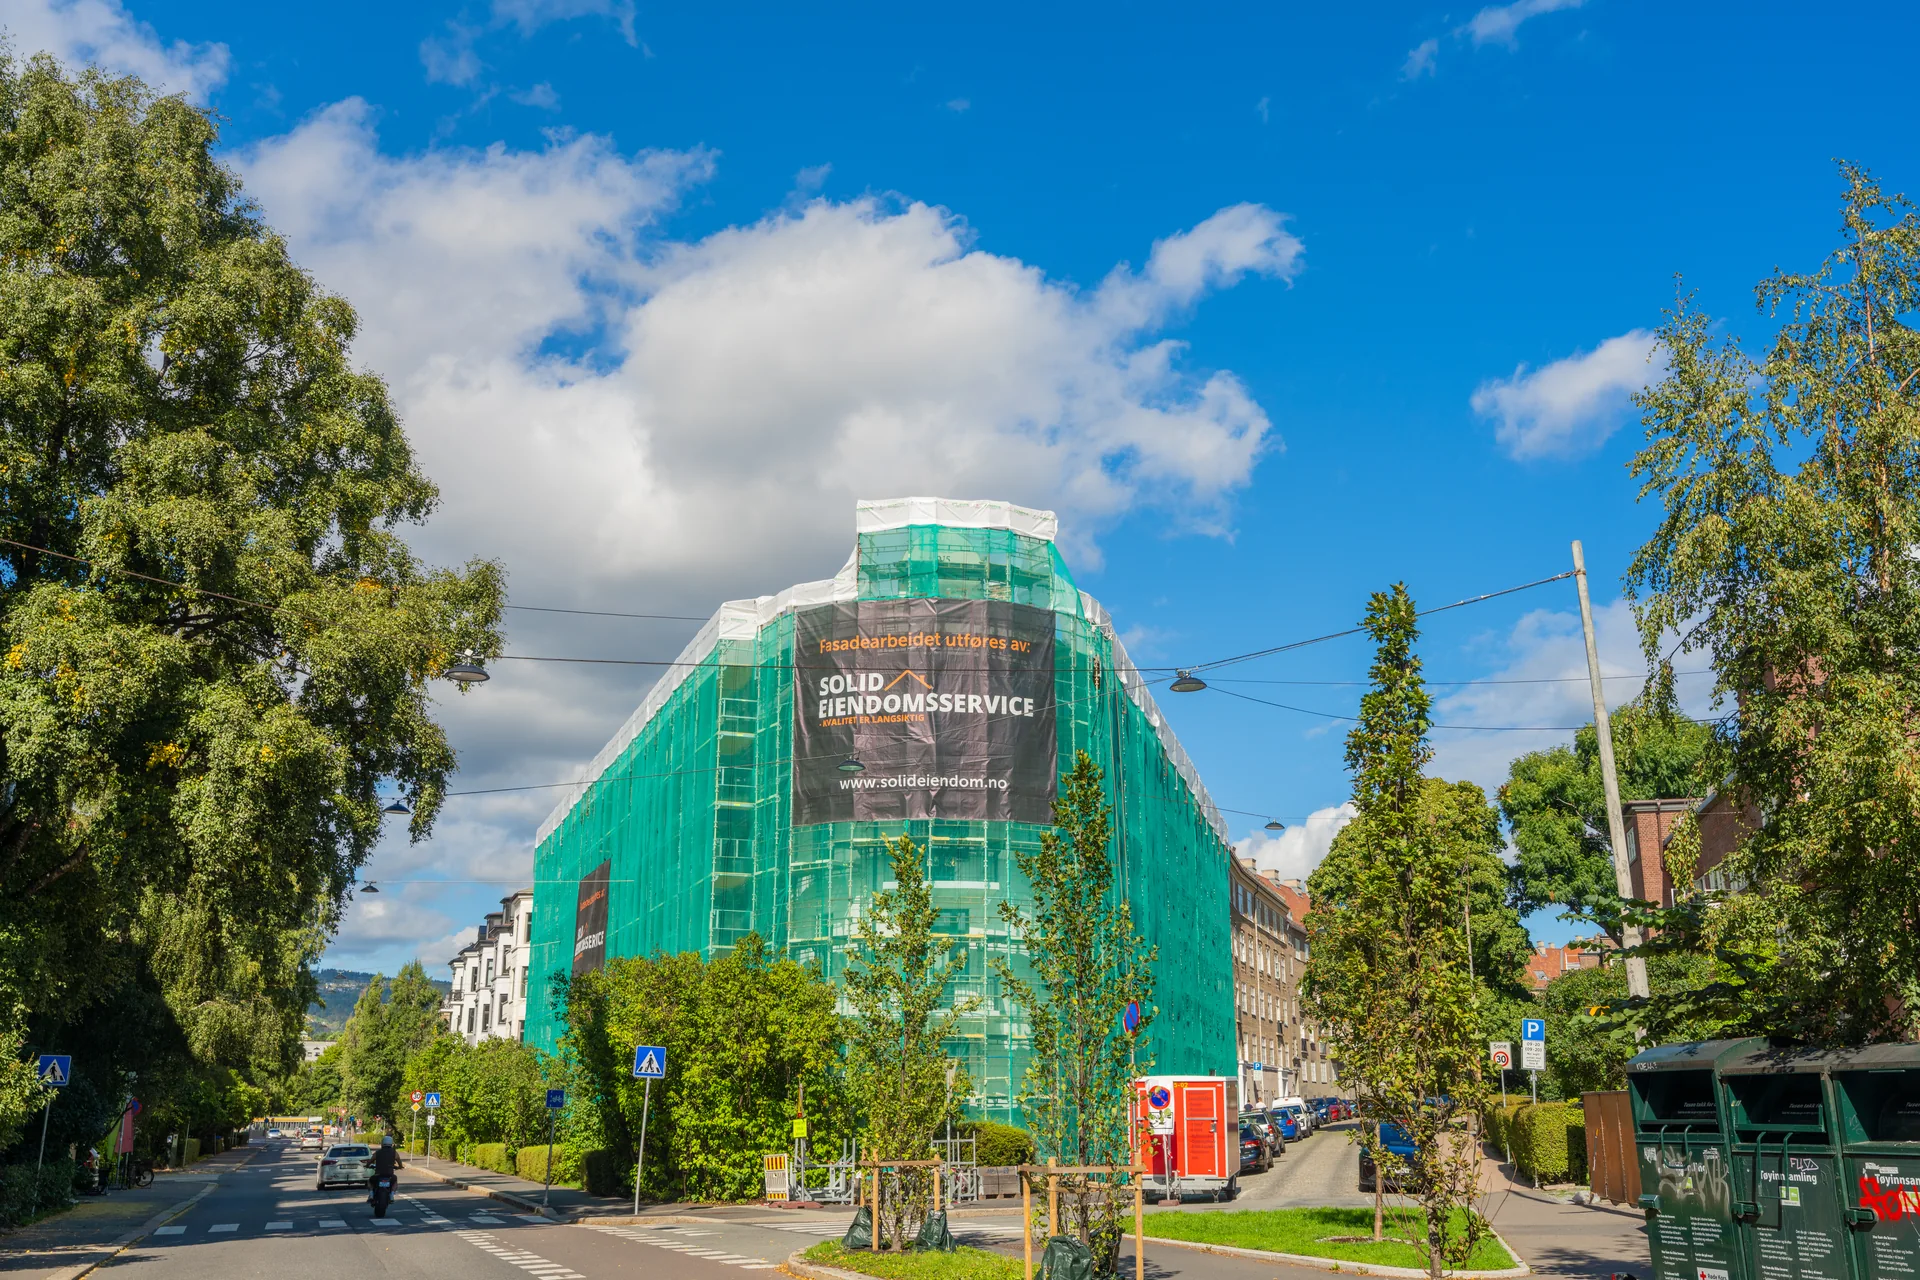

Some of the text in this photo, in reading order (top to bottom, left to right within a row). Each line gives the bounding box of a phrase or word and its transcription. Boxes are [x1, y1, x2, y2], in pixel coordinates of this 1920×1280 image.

[820, 632, 1031, 654] Fasadearbeidet utføres av:
[820, 672, 884, 696] SOLID
[819, 692, 1034, 719] EIENDOMSSERVICE
[859, 715, 870, 724] ER
[872, 713, 925, 724] LANGSIKTIG
[839, 774, 1008, 790] www.solideiendom.no
[1527, 1021, 1540, 1038] P
[1496, 1055, 1507, 1064] 30
[1760, 1170, 1818, 1185] Tøyinnamling
